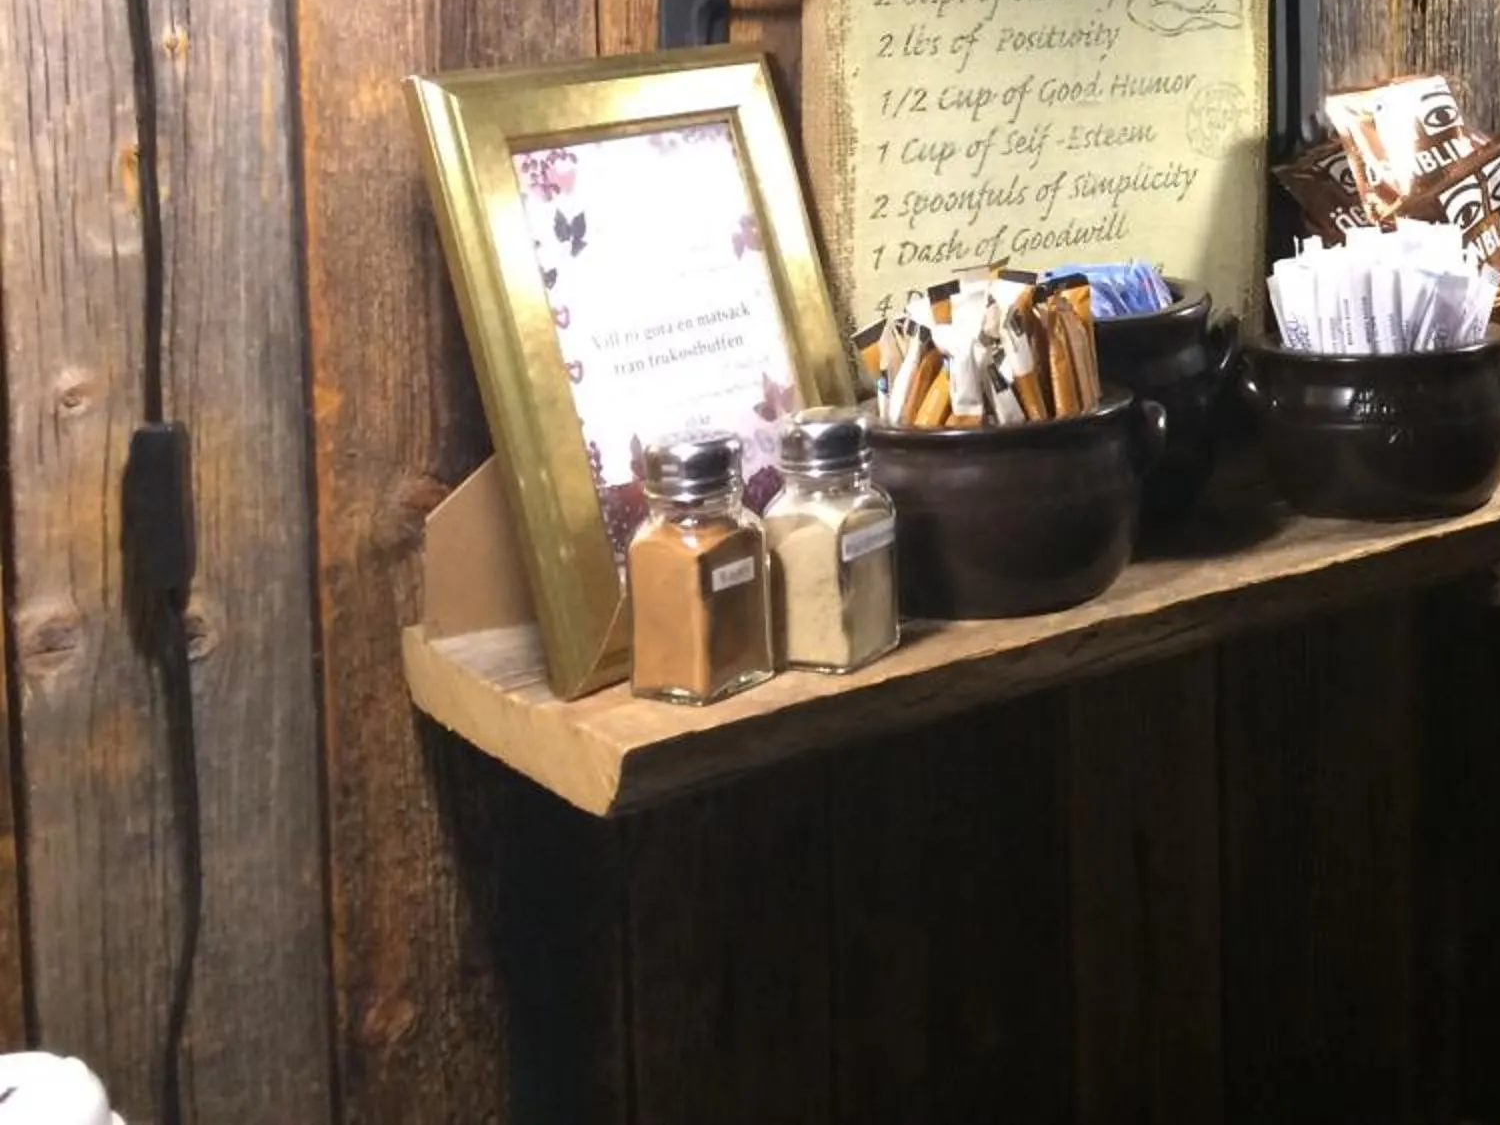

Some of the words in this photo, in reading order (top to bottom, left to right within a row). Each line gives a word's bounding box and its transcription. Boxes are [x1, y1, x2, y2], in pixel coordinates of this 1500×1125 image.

[878, 33, 894, 58] 2
[950, 23, 983, 73] of
[881, 88, 927, 118] 1/2
[938, 85, 993, 122] Cup
[1002, 76, 1034, 123] of
[1040, 73, 1100, 107] Good
[1110, 73, 1196, 97] Humor
[878, 143, 887, 164] 1
[901, 139, 955, 176] Cup
[966, 129, 998, 177] of
[869, 194, 888, 220] 2
[899, 175, 1025, 229] Spoonfuls
[1035, 171, 1067, 221] of
[1068, 165, 1198, 207] Simplicity
[873, 248, 884, 269] 1
[898, 229, 970, 268] Dash
[975, 225, 1009, 264] of
[1012, 212, 1129, 254] Goodwill
